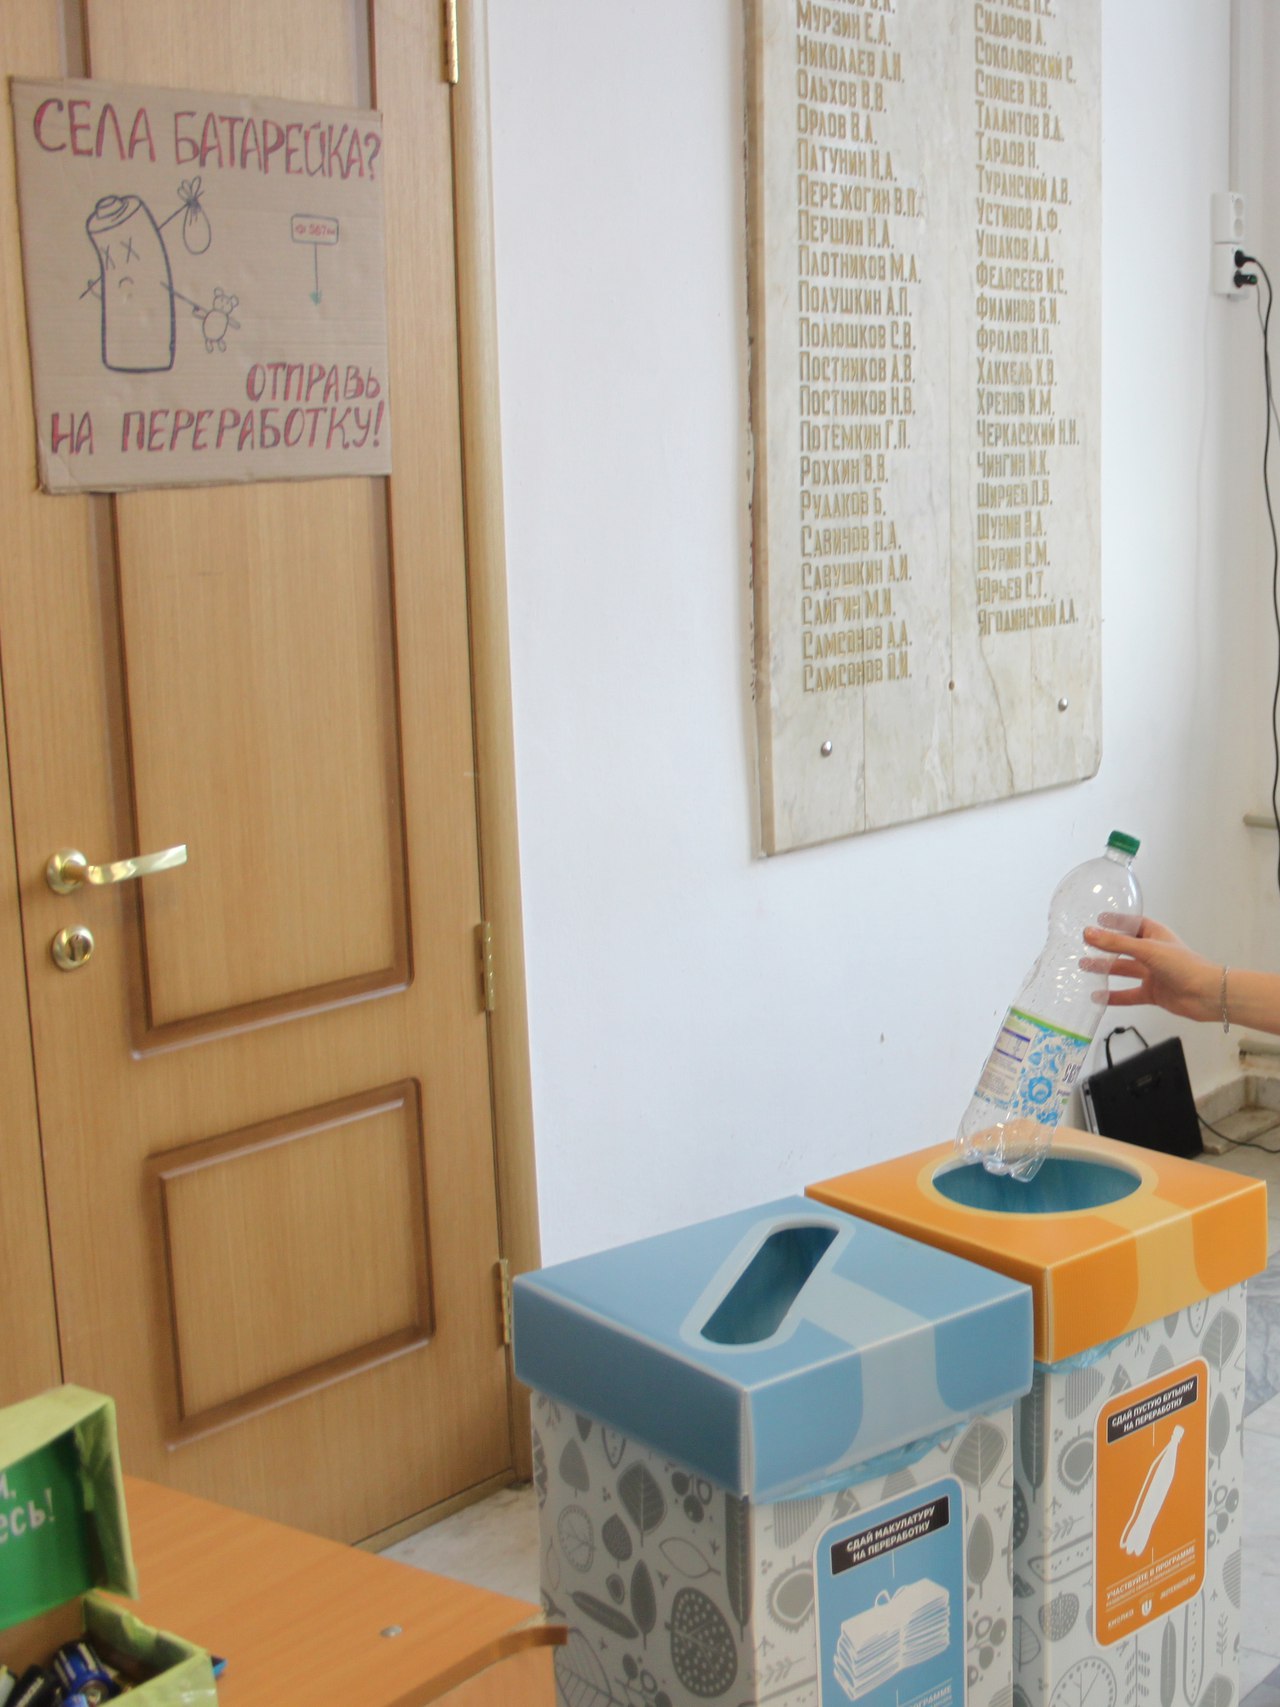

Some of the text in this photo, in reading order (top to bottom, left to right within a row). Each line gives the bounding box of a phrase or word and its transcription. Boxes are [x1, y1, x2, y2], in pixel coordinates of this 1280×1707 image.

[797, 0, 891, 47] МУРЗИН Е.А.
[975, 2, 1031, 43] СИДОРОВ
[1035, 19, 1046, 46] А.
[797, 34, 875, 77] НИКОЛАЕВ
[975, 35, 1062, 80] СОКОЛОВСКИЙ
[797, 68, 887, 112] ОЛЬХОВ В.В.
[798, 103, 878, 145] ОРЛОВ В.А.
[975, 100, 1039, 138] ТАЛАНТОВ
[34, 98, 382, 180] СЕЛА БАТАРЕЙКА?
[798, 139, 867, 178] ПАТУНИН
[799, 174, 920, 218] ПЕРЕЖОГИН В.П.
[976, 164, 1047, 201] ТУРАНСКИЙ
[799, 209, 894, 249] ПЕРШИН Н.А.
[976, 197, 1062, 234] УСТИНОВ А.Ф.
[976, 229, 1054, 262] УШАКОВ А.А.
[799, 245, 921, 284] ПЛОТНИКОВ М.А.
[976, 261, 1043, 292] ФЕДОСЕЕВ
[799, 280, 912, 317] ПОЛУШКИН А.П.
[800, 317, 916, 351] ПОЛЮШКОВ С.В.
[977, 324, 1028, 353] ФРОЛОВ
[247, 362, 381, 402] ОТПРАВЬ
[800, 351, 916, 383] ПОСТНИКОВ А.В.
[800, 385, 916, 416] ПОСТНИКОВ Н.В.
[977, 387, 1025, 416] ХРЕНОВ
[51, 400, 385, 455] НА ПЕРЕРАБОТКУ!
[800, 419, 910, 452] ПОТЕМКИН Г.П.
[977, 417, 1055, 447] ЧЕРКАССКИЙ
[800, 453, 888, 486] РОХКИН В.В.
[800, 487, 886, 520] РУДАКОВ Б.
[801, 525, 869, 558] САВИНОВ
[801, 560, 883, 591] САВУШКИН
[977, 576, 1021, 605] ЮРЬЕВ
[802, 590, 860, 626] САЙГИН
[803, 620, 912, 659] САМСОНОВ А.А.
[804, 658, 883, 693] САМСОНОВ
[1112, 1381, 1194, 1427] СДАЙ ПУСТУЮ БУТЫЛКУ
[1124, 1397, 1183, 1432] НА ПЕРЕРАБОТКУ
[0, 1487, 55, 1543] есь!
[846, 1506, 935, 1552] СДАЙ МАКУЛАТУРУ
[853, 1520, 930, 1562] НА ПЕРЕРАБОТКУ
